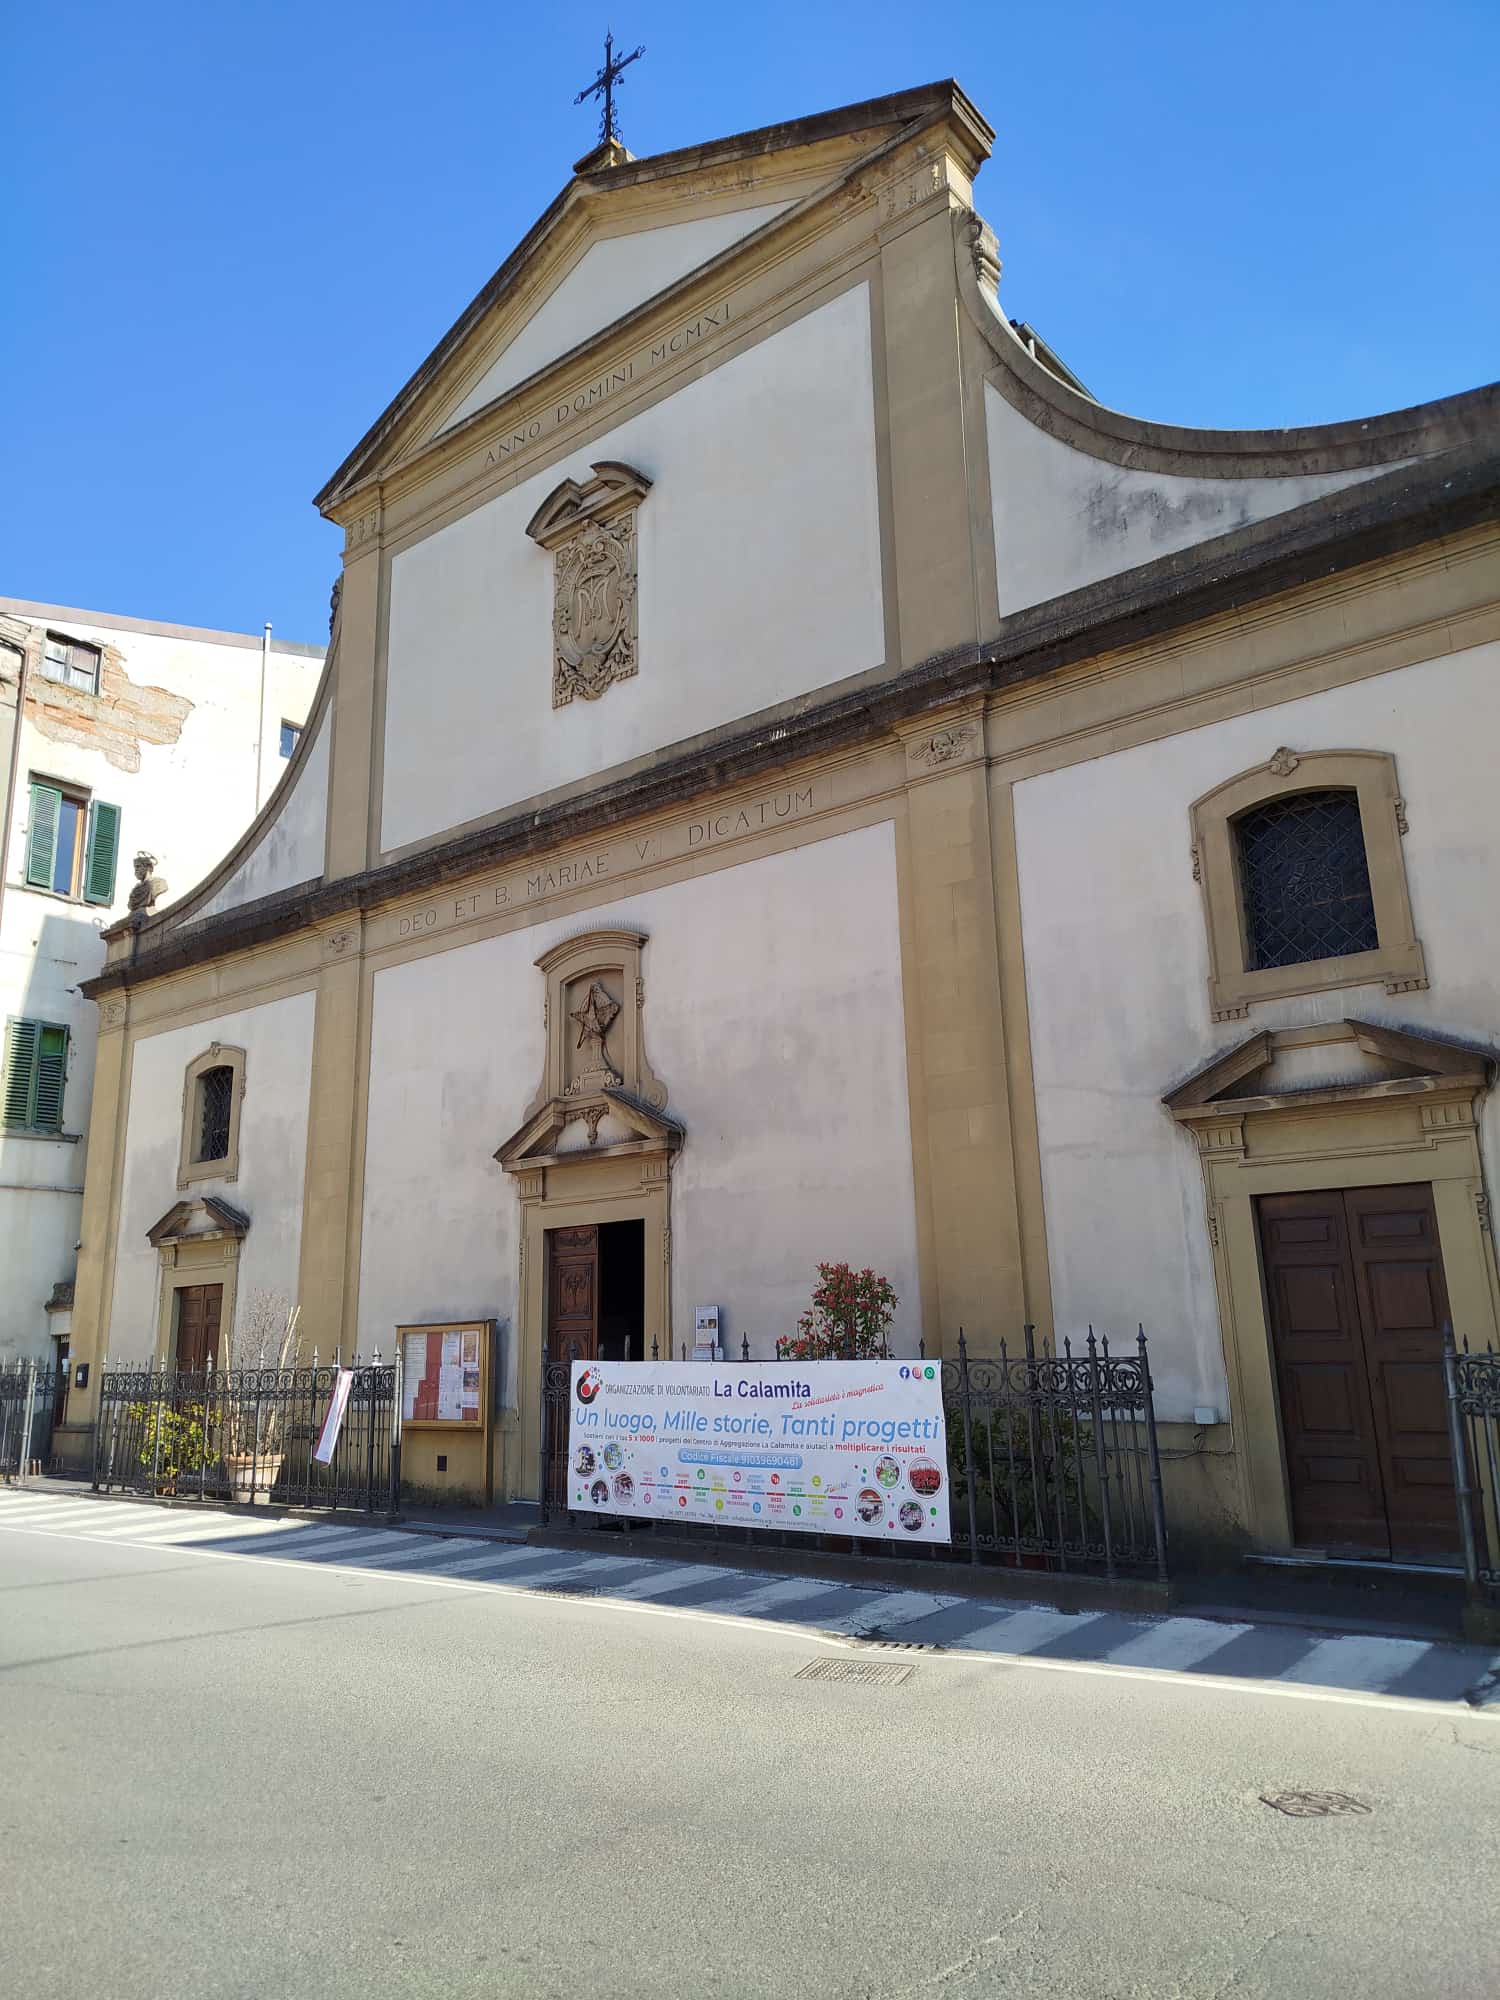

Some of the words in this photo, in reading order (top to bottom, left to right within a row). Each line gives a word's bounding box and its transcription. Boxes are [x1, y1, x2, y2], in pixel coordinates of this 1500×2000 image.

[484, 421, 542, 466] ANNO
[556, 363, 634, 424] DOMINI
[651, 303, 730, 365] MCMXI
[399, 909, 438, 936] DEO
[455, 894, 482, 919] ET
[527, 853, 610, 897] MARIAE
[689, 787, 815, 847] DICATUM
[605, 1384, 655, 1395] ORGANIZZAZIONE
[657, 1384, 664, 1395] DI
[665, 1384, 711, 1397] VOLONTARIATO
[714, 1379, 733, 1398] La
[737, 1380, 811, 1399] Calamita
[576, 1407, 599, 1426] Un
[603, 1408, 657, 1433] luogo,
[664, 1411, 708, 1432] Mille
[713, 1413, 773, 1438] storie,
[781, 1413, 836, 1437] Tanti
[842, 1415, 939, 1443] progetti
[639, 1434, 655, 1442] 1000
[720, 1439, 760, 1449] Aggregazione
[770, 1441, 799, 1449] Calamita
[835, 1443, 885, 1452] moltiplicare
[891, 1444, 926, 1454] risultati
